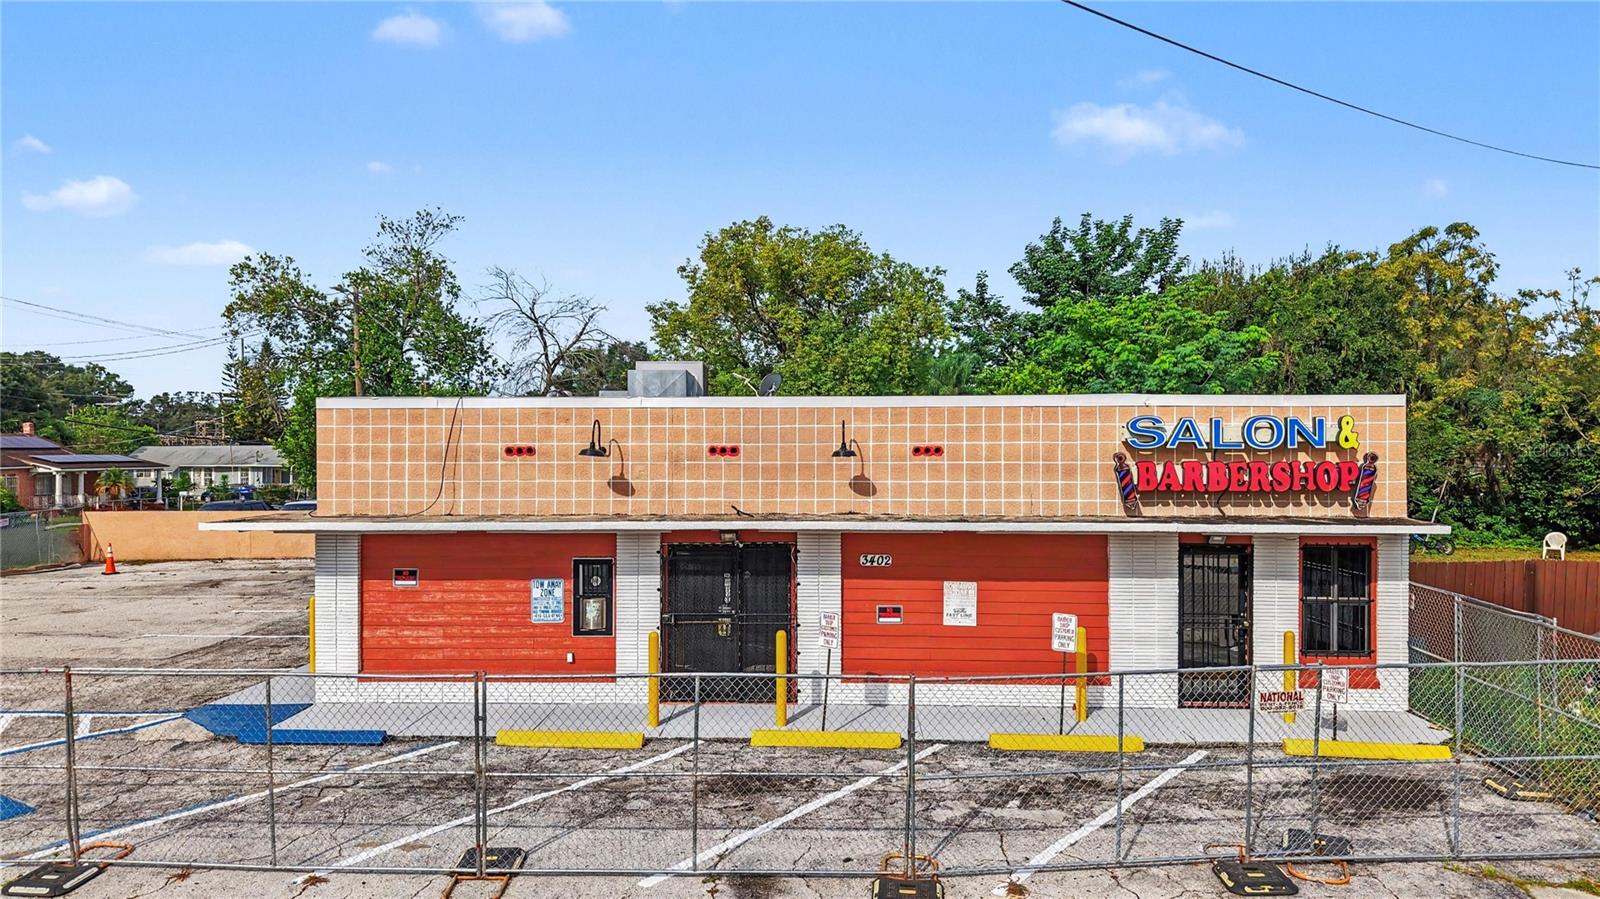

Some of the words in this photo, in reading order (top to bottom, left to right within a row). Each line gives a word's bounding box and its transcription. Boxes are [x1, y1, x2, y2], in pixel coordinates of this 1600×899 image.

[1126, 415, 1327, 450] SALON
[1338, 415, 1360, 450] &
[1135, 460, 1359, 493] BARBERSHOP
[861, 555, 891, 566] 3402
[533, 580, 545, 589] TOW
[547, 580, 562, 588] AWAY
[540, 588, 555, 597] ZONE
[821, 631, 838, 639] PARKING
[1055, 634, 1075, 642] PARKING
[1322, 686, 1345, 695] PARKING
[1260, 691, 1304, 702] NATIONAL
[1327, 693, 1341, 701] ONLY
